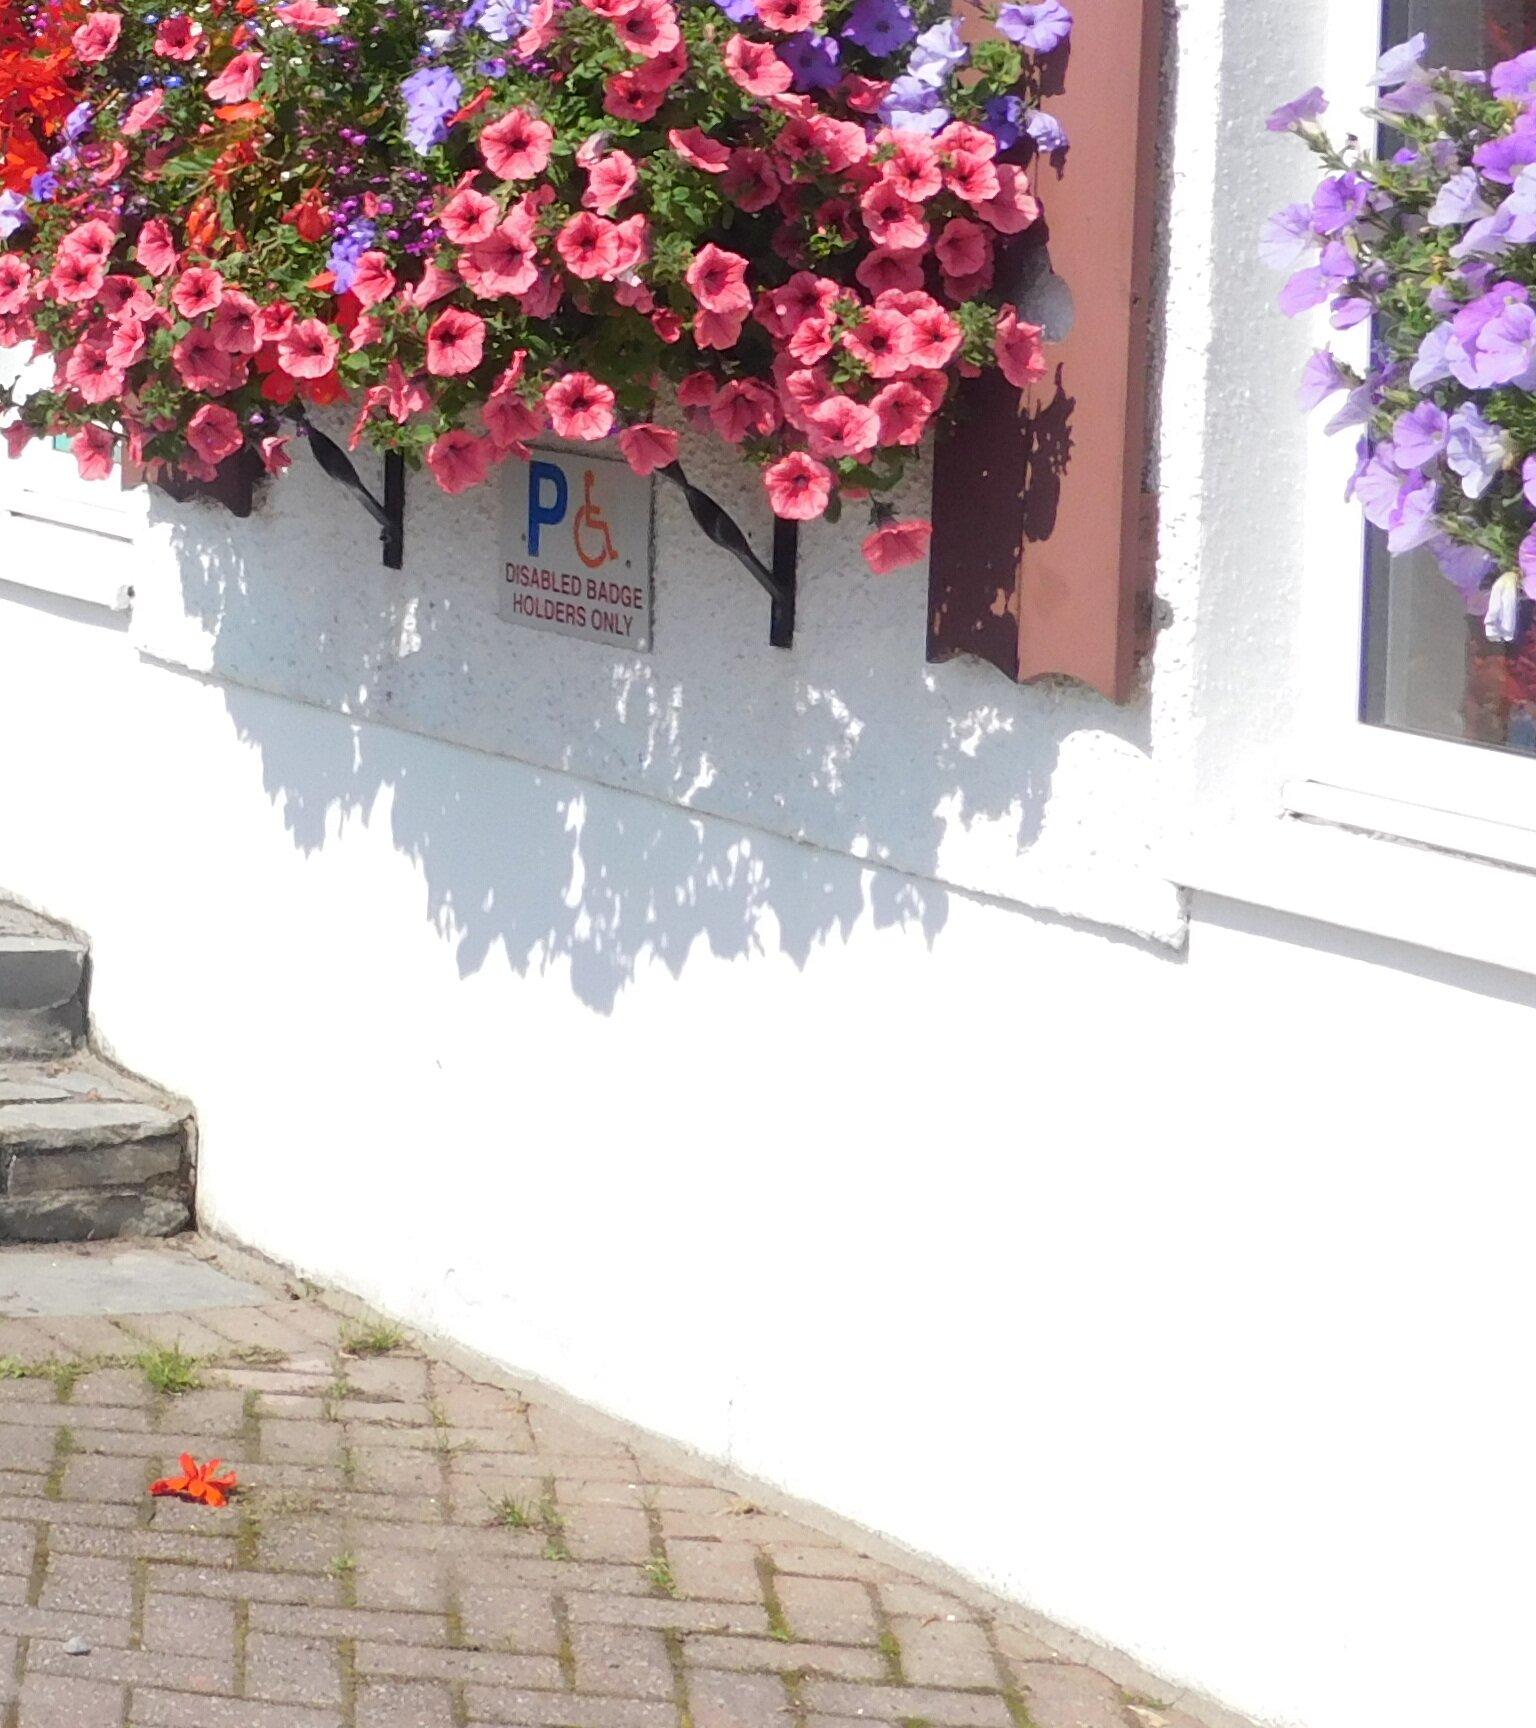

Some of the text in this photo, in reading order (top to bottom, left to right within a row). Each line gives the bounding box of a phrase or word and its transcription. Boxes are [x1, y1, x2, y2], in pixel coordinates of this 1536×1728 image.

[528, 459, 568, 558] P
[505, 562, 643, 610] DISABLED BADGE
[513, 592, 634, 637] HOLDERS ONLY
